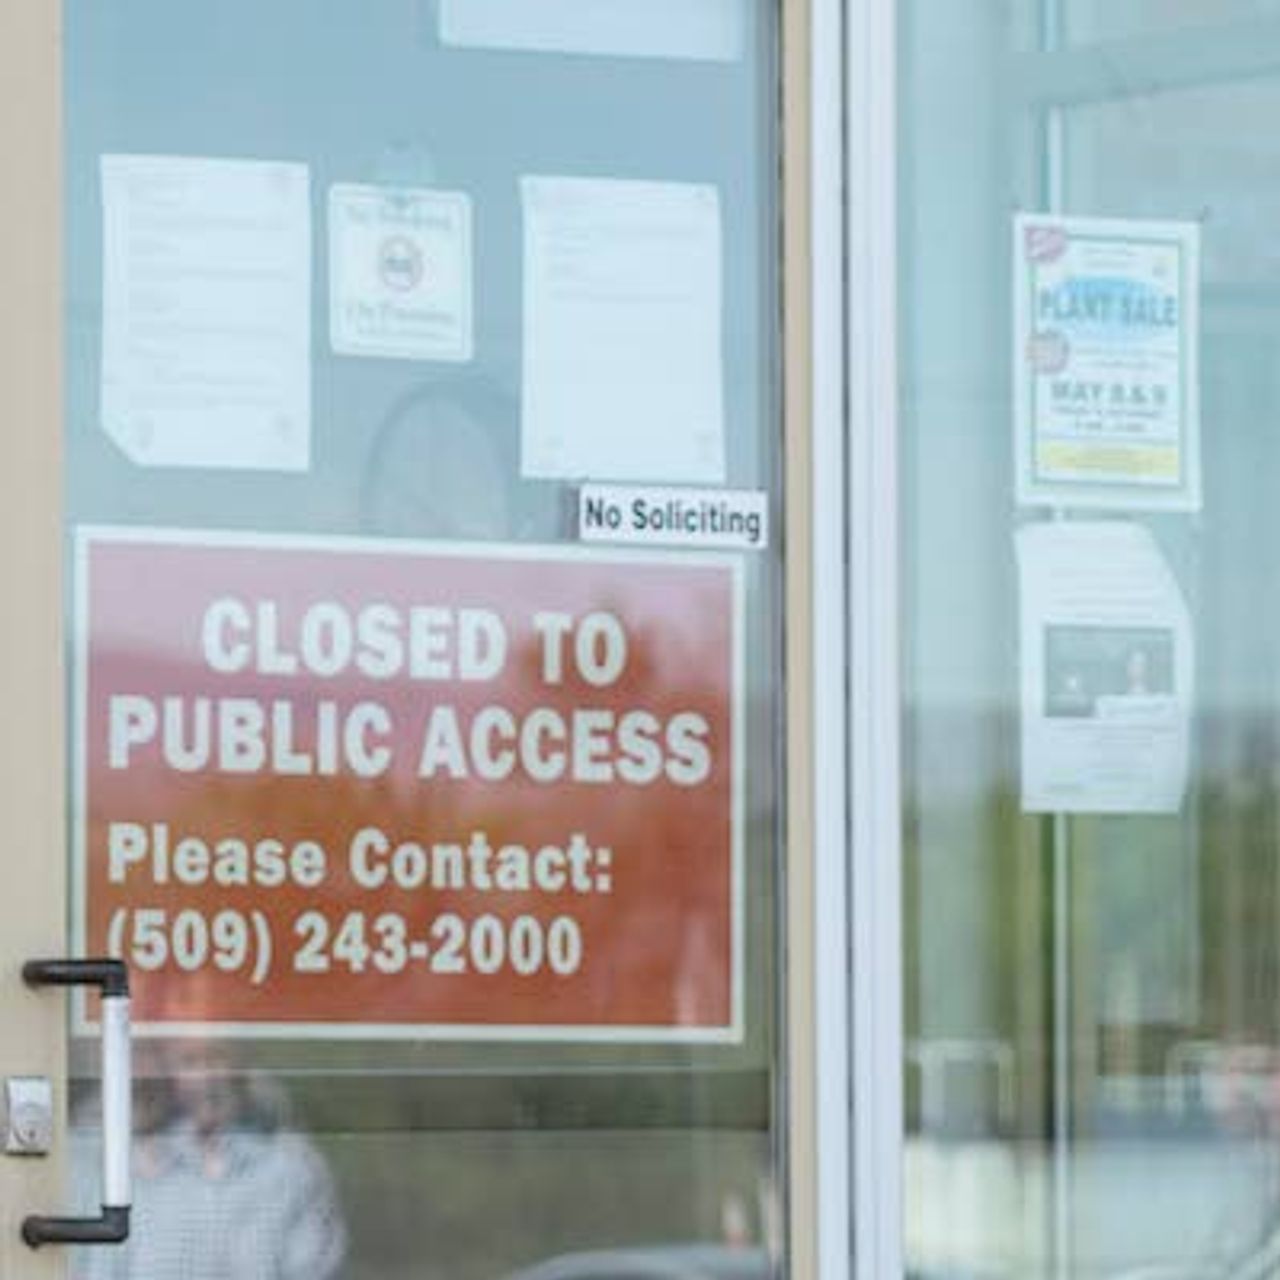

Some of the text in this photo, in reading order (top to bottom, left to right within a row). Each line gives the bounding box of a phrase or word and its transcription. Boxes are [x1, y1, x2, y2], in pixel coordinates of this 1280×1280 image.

[585, 497, 761, 543] No Soliciting
[203, 599, 626, 686] CLOSED TO
[109, 696, 712, 784] PUBLIC ACCESS
[108, 823, 612, 891] Please Contact:
[108, 909, 582, 984] (509) 243-2000
